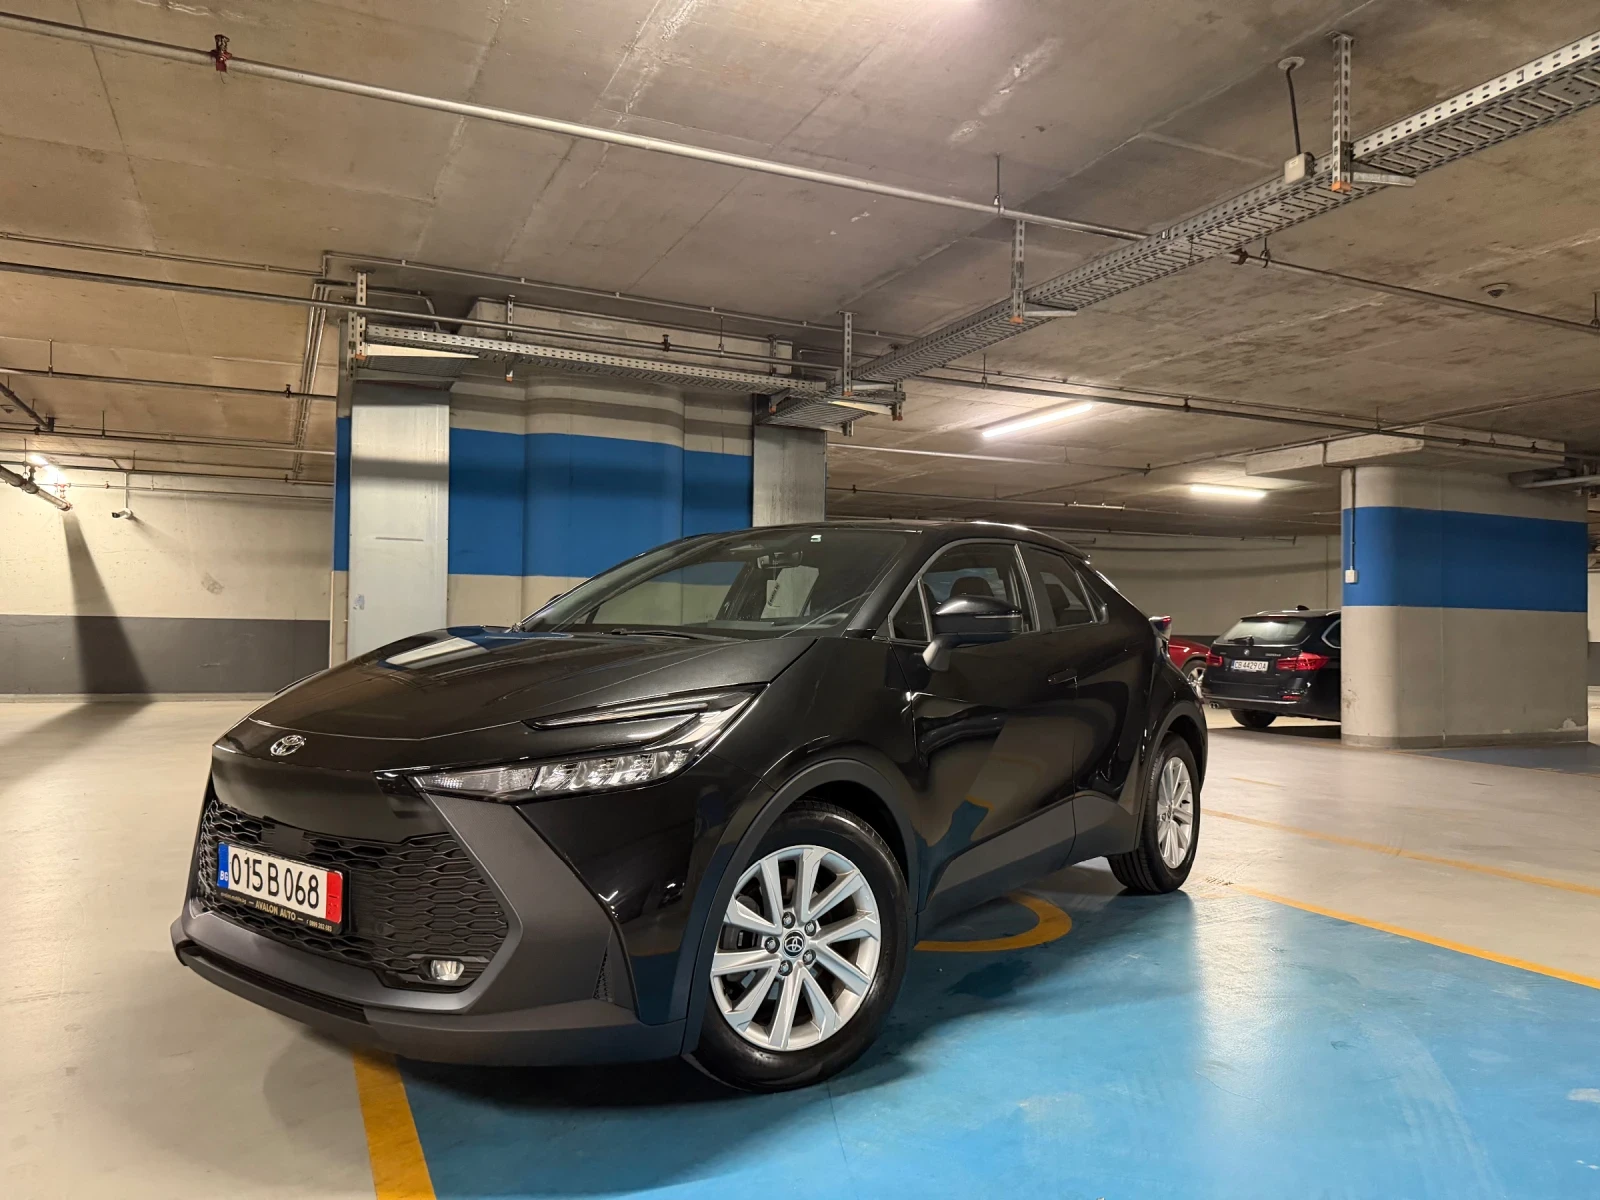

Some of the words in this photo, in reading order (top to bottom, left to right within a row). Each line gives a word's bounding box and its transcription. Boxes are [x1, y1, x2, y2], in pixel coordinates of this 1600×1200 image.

[219, 870, 229, 882] BG
[255, 900, 278, 916] AVALON
[280, 908, 296, 921] AUTO
